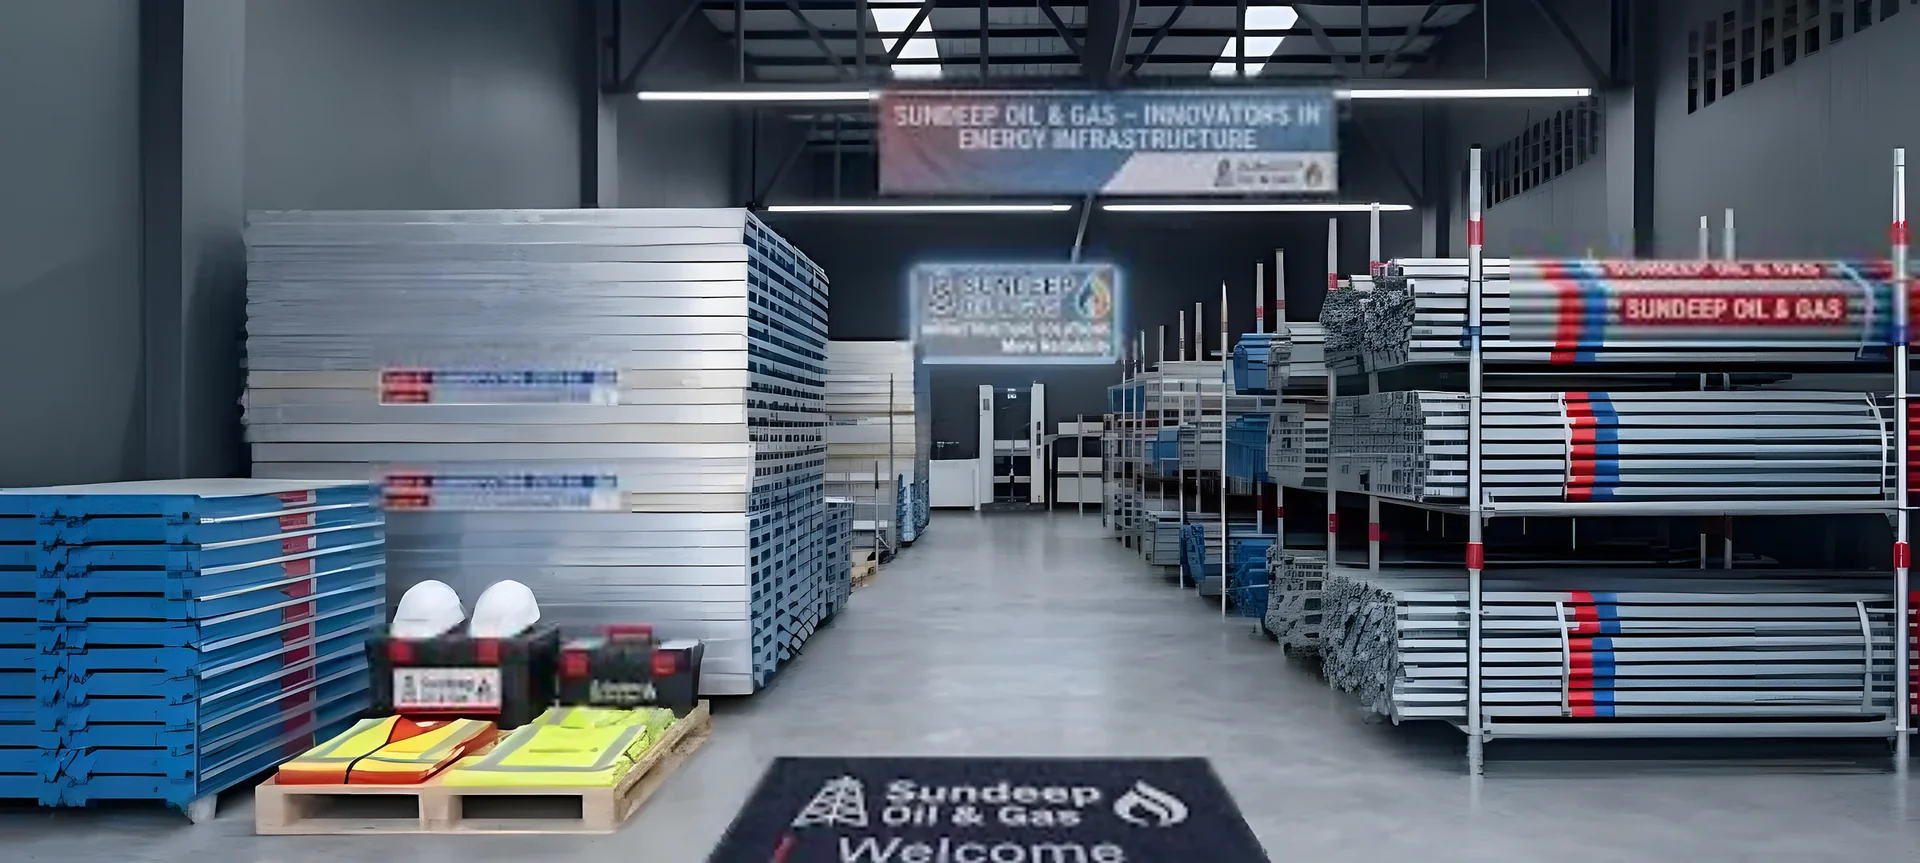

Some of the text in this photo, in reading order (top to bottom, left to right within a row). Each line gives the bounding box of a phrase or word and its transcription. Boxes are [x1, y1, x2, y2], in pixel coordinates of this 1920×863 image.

[894, 105, 998, 126] SUNDEEP
[1005, 105, 1042, 126] OIL
[1048, 105, 1064, 126] &
[1071, 105, 1117, 126] GAS
[1144, 105, 1292, 126] INNOVATORS
[1299, 105, 1320, 126] IN
[959, 128, 1257, 149] ENERGY INFRASTRUCTURE
[1626, 298, 1842, 320] SUNDEEP OIL & GAS
[886, 779, 1101, 808] Sundeep
[882, 804, 1081, 827] Oil & Gas
[838, 836, 1126, 863] Welcome
